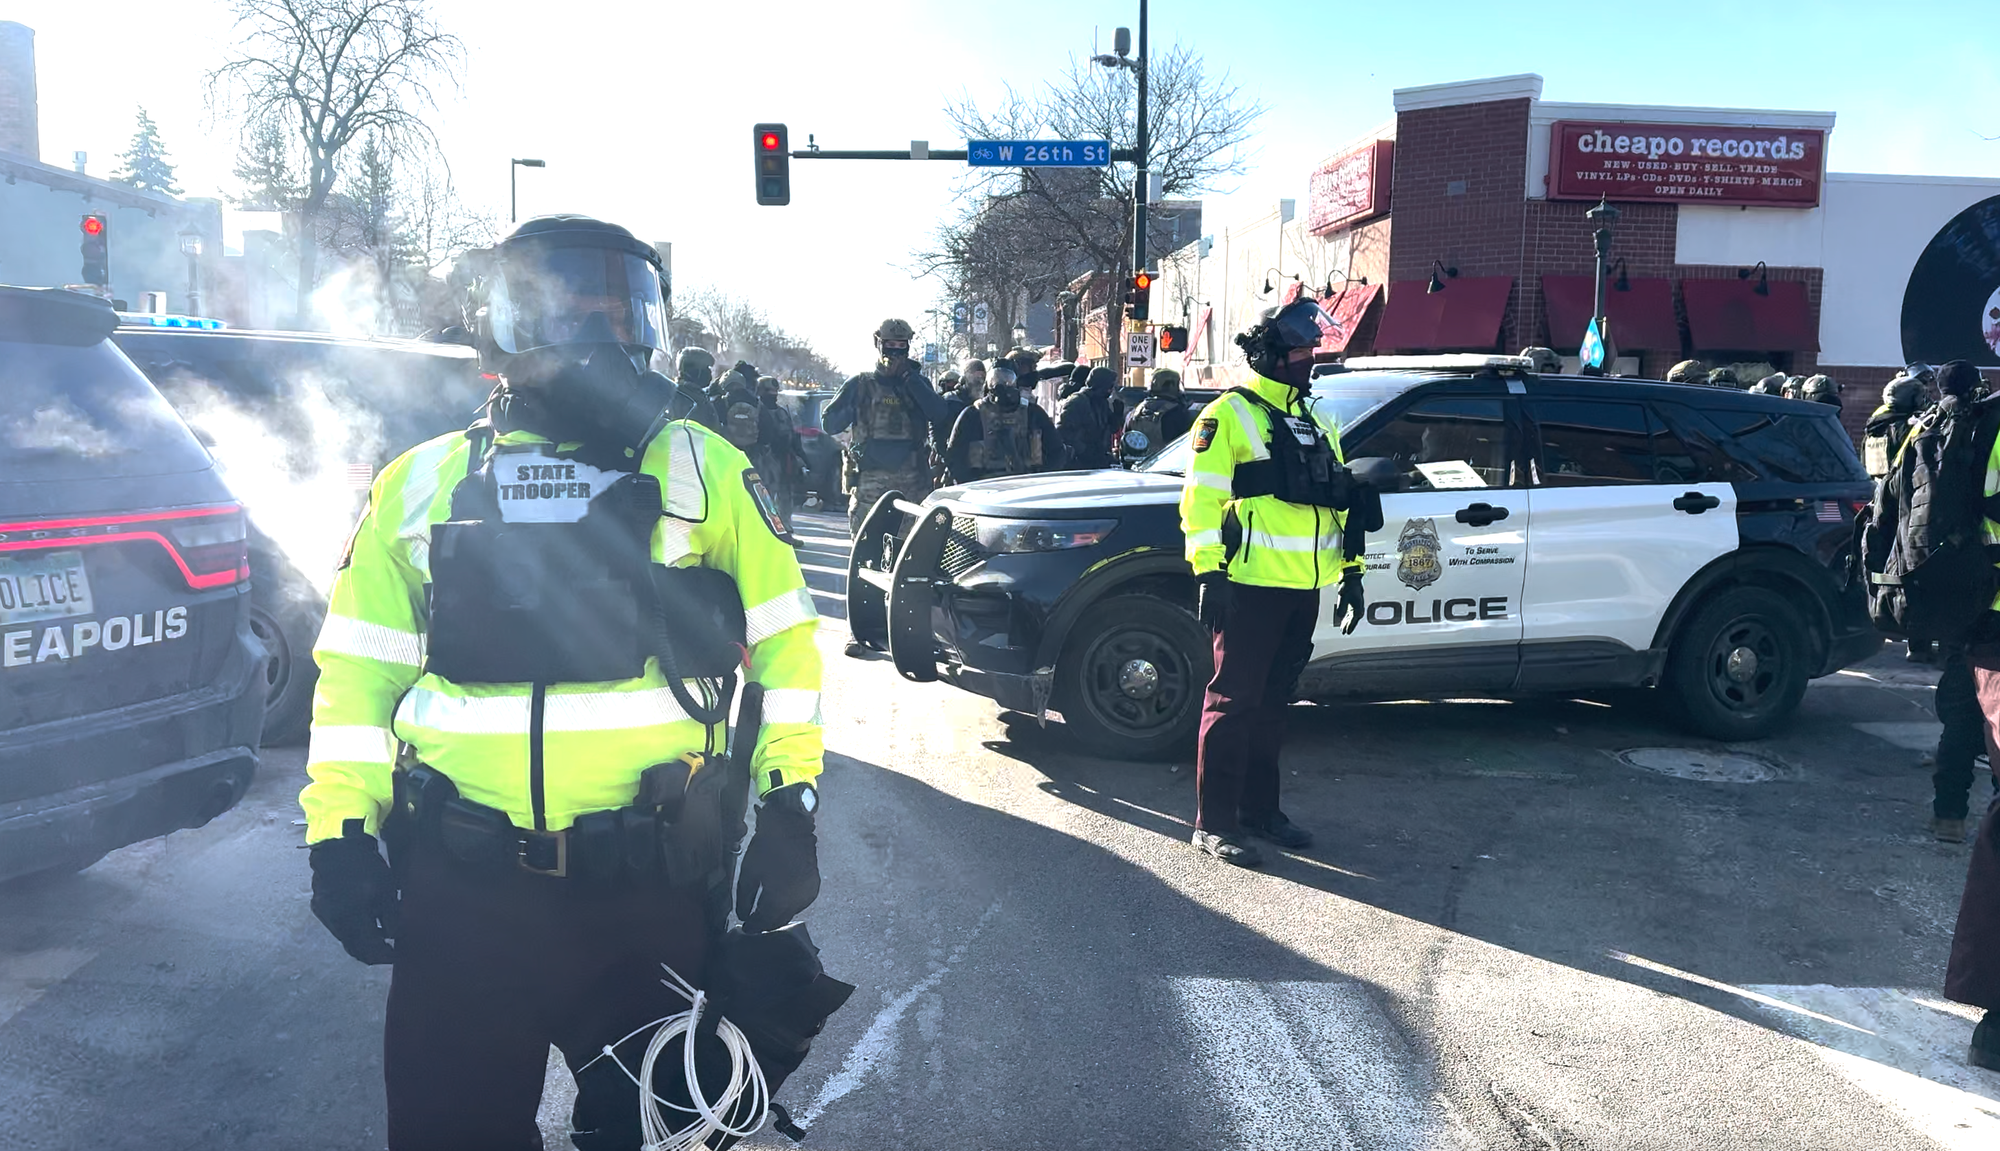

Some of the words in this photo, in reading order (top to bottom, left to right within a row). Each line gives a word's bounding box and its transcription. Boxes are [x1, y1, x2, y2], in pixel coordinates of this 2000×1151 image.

[1578, 129, 1684, 159] cheapo
[1690, 136, 1805, 160] records
[998, 145, 1014, 161] W
[1024, 145, 1073, 161] 26th
[1083, 145, 1105, 161] St
[1603, 160, 1631, 169] NEW
[1637, 161, 1668, 170] USED
[1674, 162, 1699, 171] BUY
[1704, 163, 1734, 172] SELL
[1739, 164, 1778, 174] TRADE
[1576, 171, 1613, 180] VINYL
[1616, 172, 1637, 181] LPs
[1642, 173, 1663, 182] CDs
[1668, 174, 1697, 183] DVDs
[1703, 176, 1755, 185] T-SHIRTS
[1761, 177, 1803, 187] MERCH
[1654, 185, 1686, 195] OPEN
[1688, 186, 1724, 196] DAILY
[1131, 335, 1149, 344] ONE
[1131, 344, 1149, 353] WAY
[517, 465, 576, 481] STATE
[500, 483, 591, 500] TROOPER
